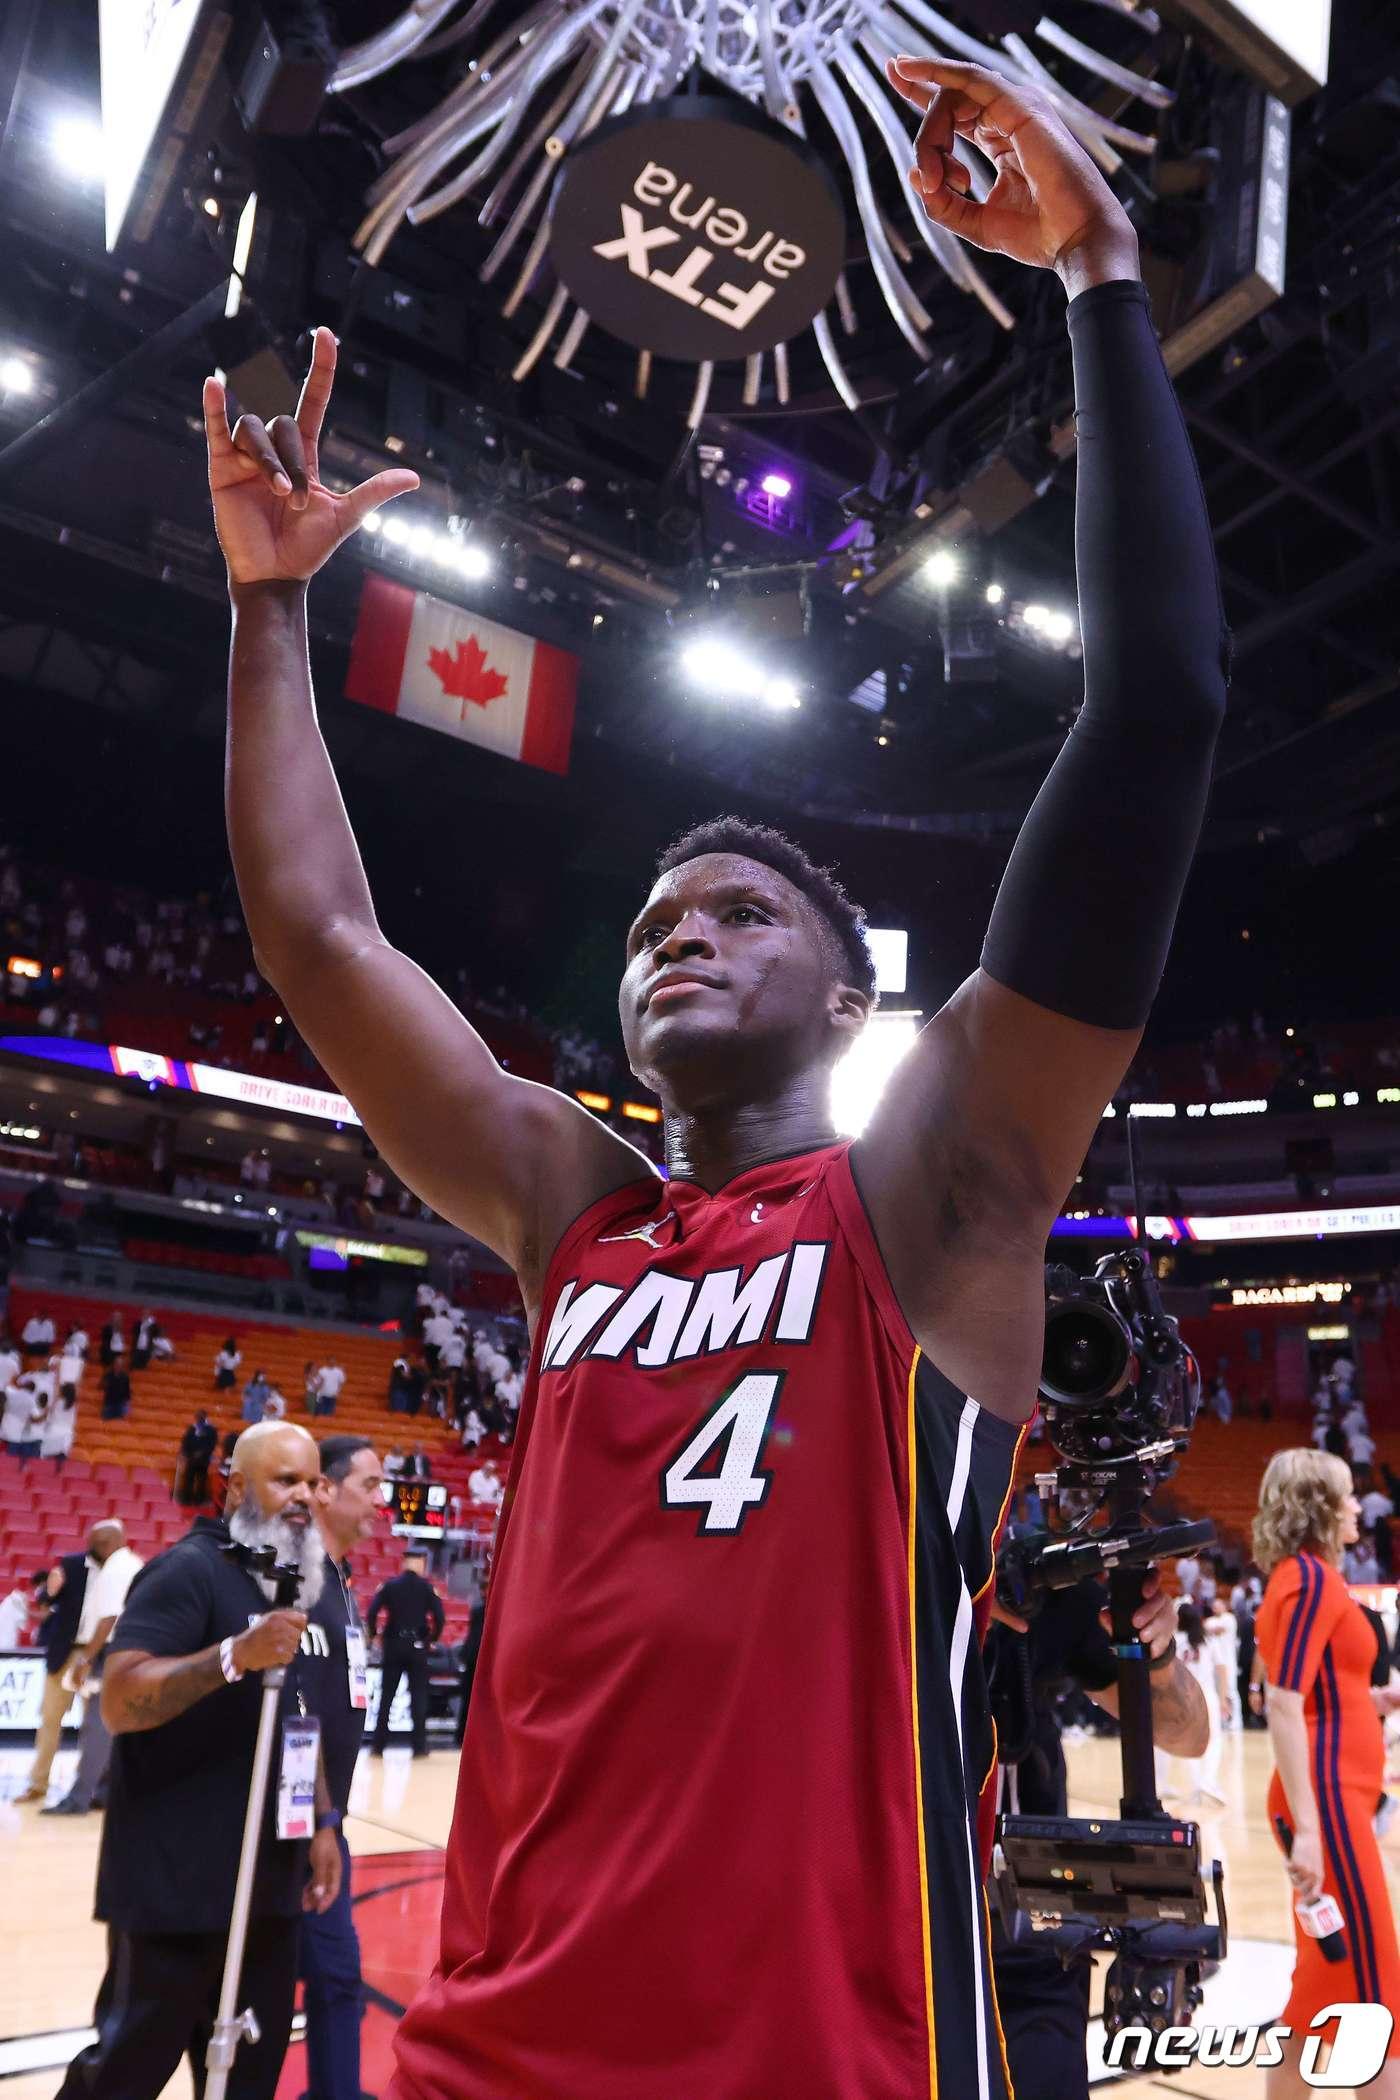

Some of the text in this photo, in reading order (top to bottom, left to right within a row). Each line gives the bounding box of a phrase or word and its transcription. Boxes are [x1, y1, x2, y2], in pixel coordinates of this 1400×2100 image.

[592, 203, 776, 331] FTX
[633, 161, 807, 279] arena
[540, 1240, 833, 1376] MAMI
[659, 1367, 788, 1537] 4
